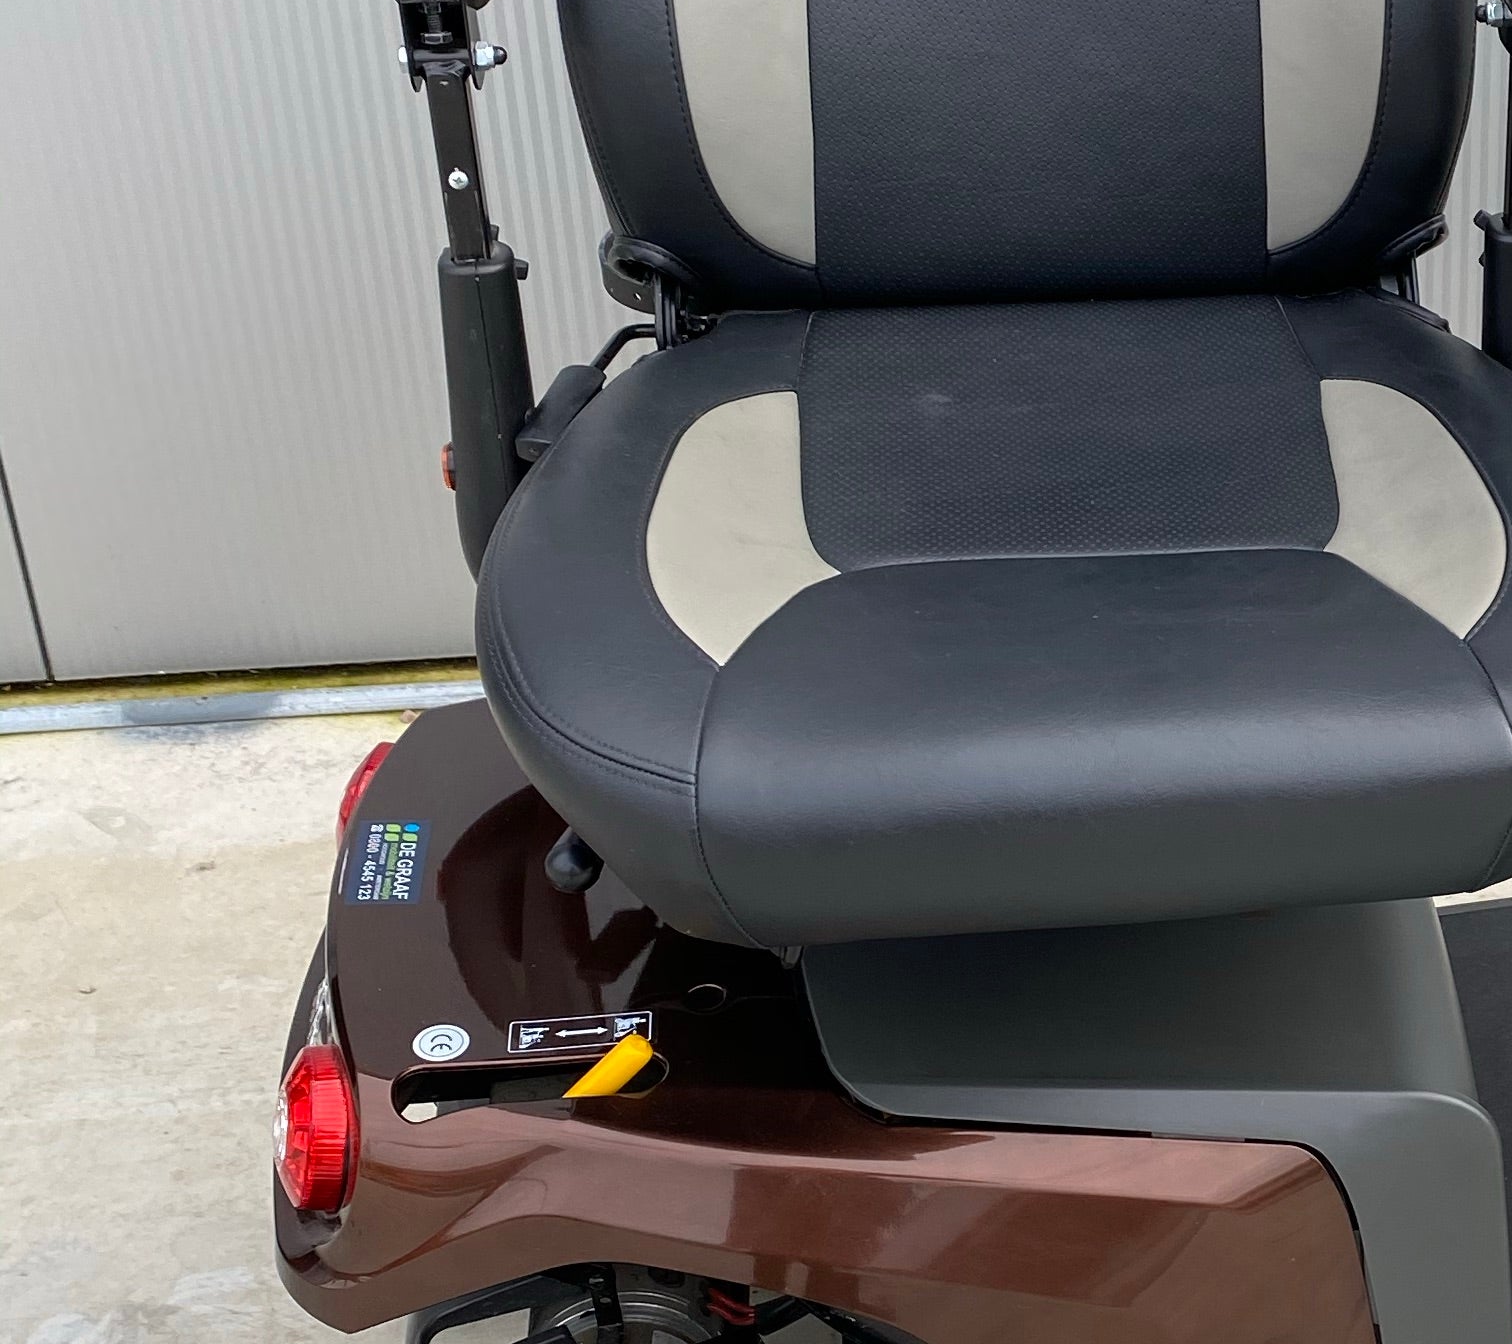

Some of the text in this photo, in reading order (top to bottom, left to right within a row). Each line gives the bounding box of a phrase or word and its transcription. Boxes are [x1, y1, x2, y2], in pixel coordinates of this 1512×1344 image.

[393, 843, 417, 900] DE GRAAF
[357, 884, 373, 901] 123
